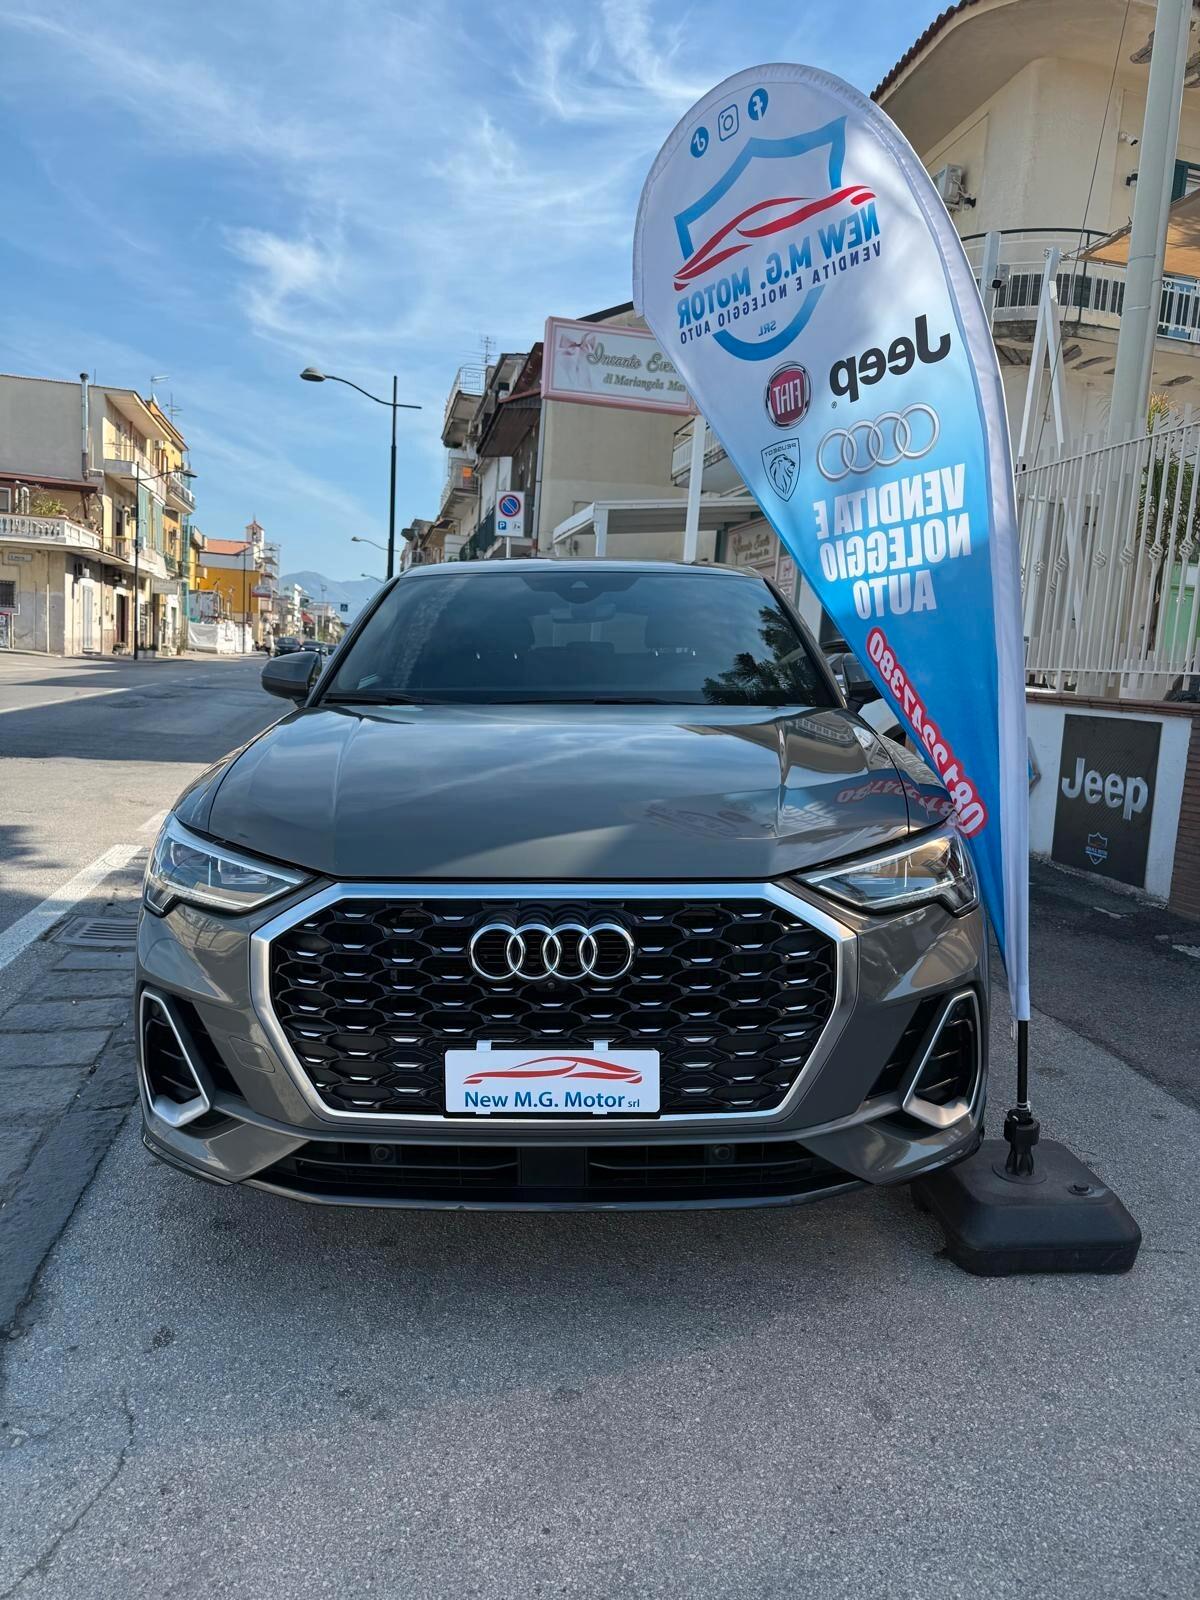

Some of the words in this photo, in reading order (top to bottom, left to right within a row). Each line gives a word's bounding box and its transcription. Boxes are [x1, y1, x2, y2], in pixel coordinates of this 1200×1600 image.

[586, 342, 642, 370] Incanto
[614, 375, 664, 392] Mariangela
[1061, 757, 1148, 821] Jeep
[464, 1091, 508, 1108] New
[514, 1091, 559, 1108] M.G.
[564, 1091, 626, 1108] Motor
[628, 1098, 640, 1108] srl
